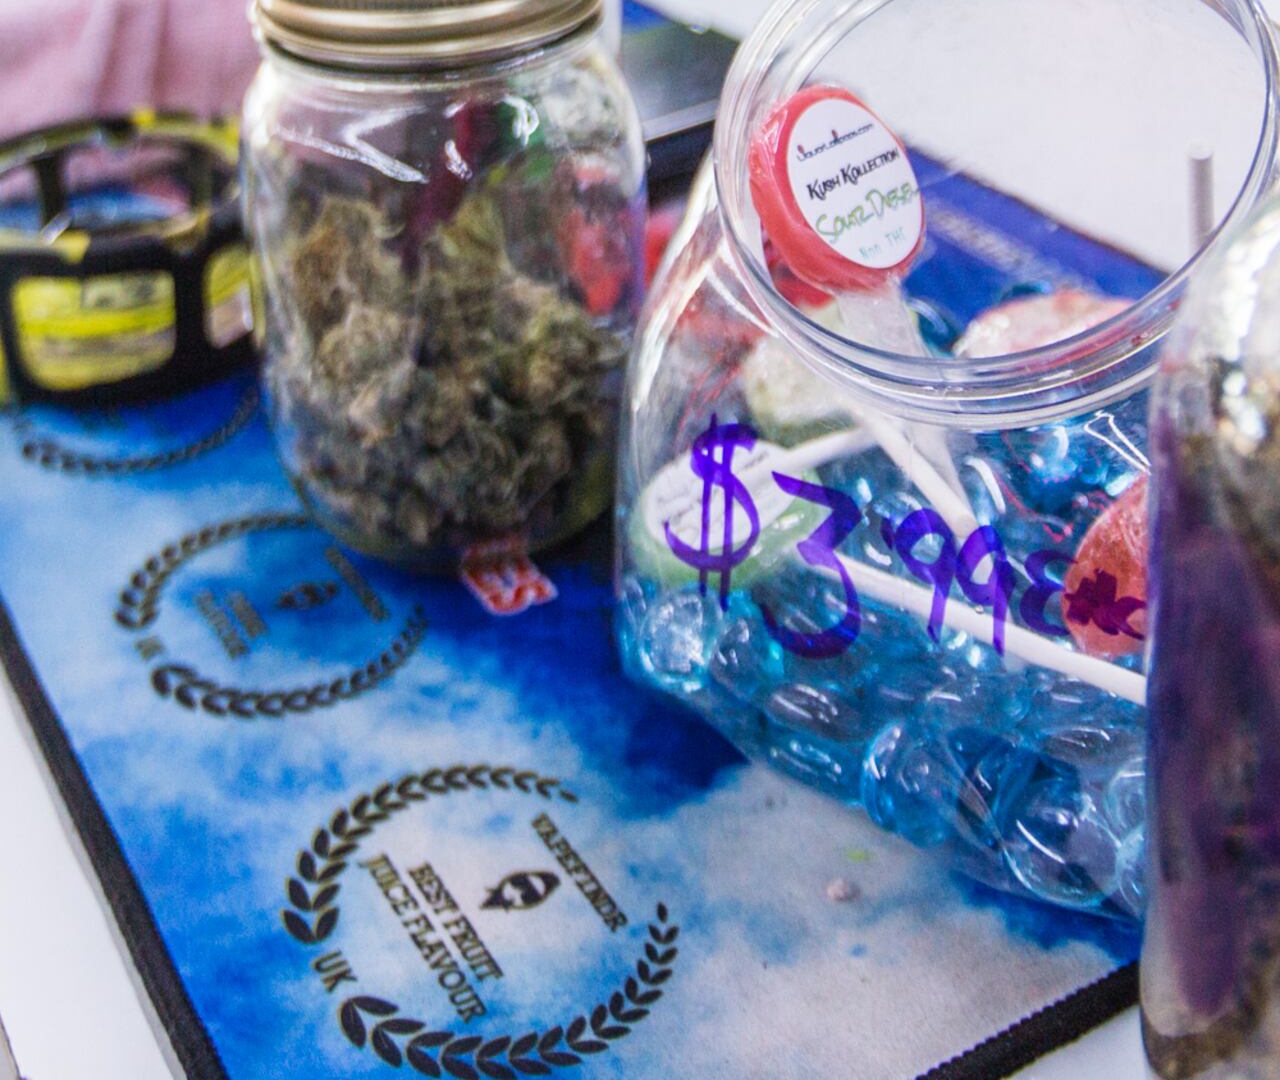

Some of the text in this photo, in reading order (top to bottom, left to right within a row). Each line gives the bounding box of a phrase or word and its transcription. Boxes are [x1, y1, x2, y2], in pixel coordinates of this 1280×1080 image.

[312, 949, 357, 993] UK
[357, 852, 487, 1023] JUICE FLAVOUR
[407, 861, 503, 982] BEST FRUIT
